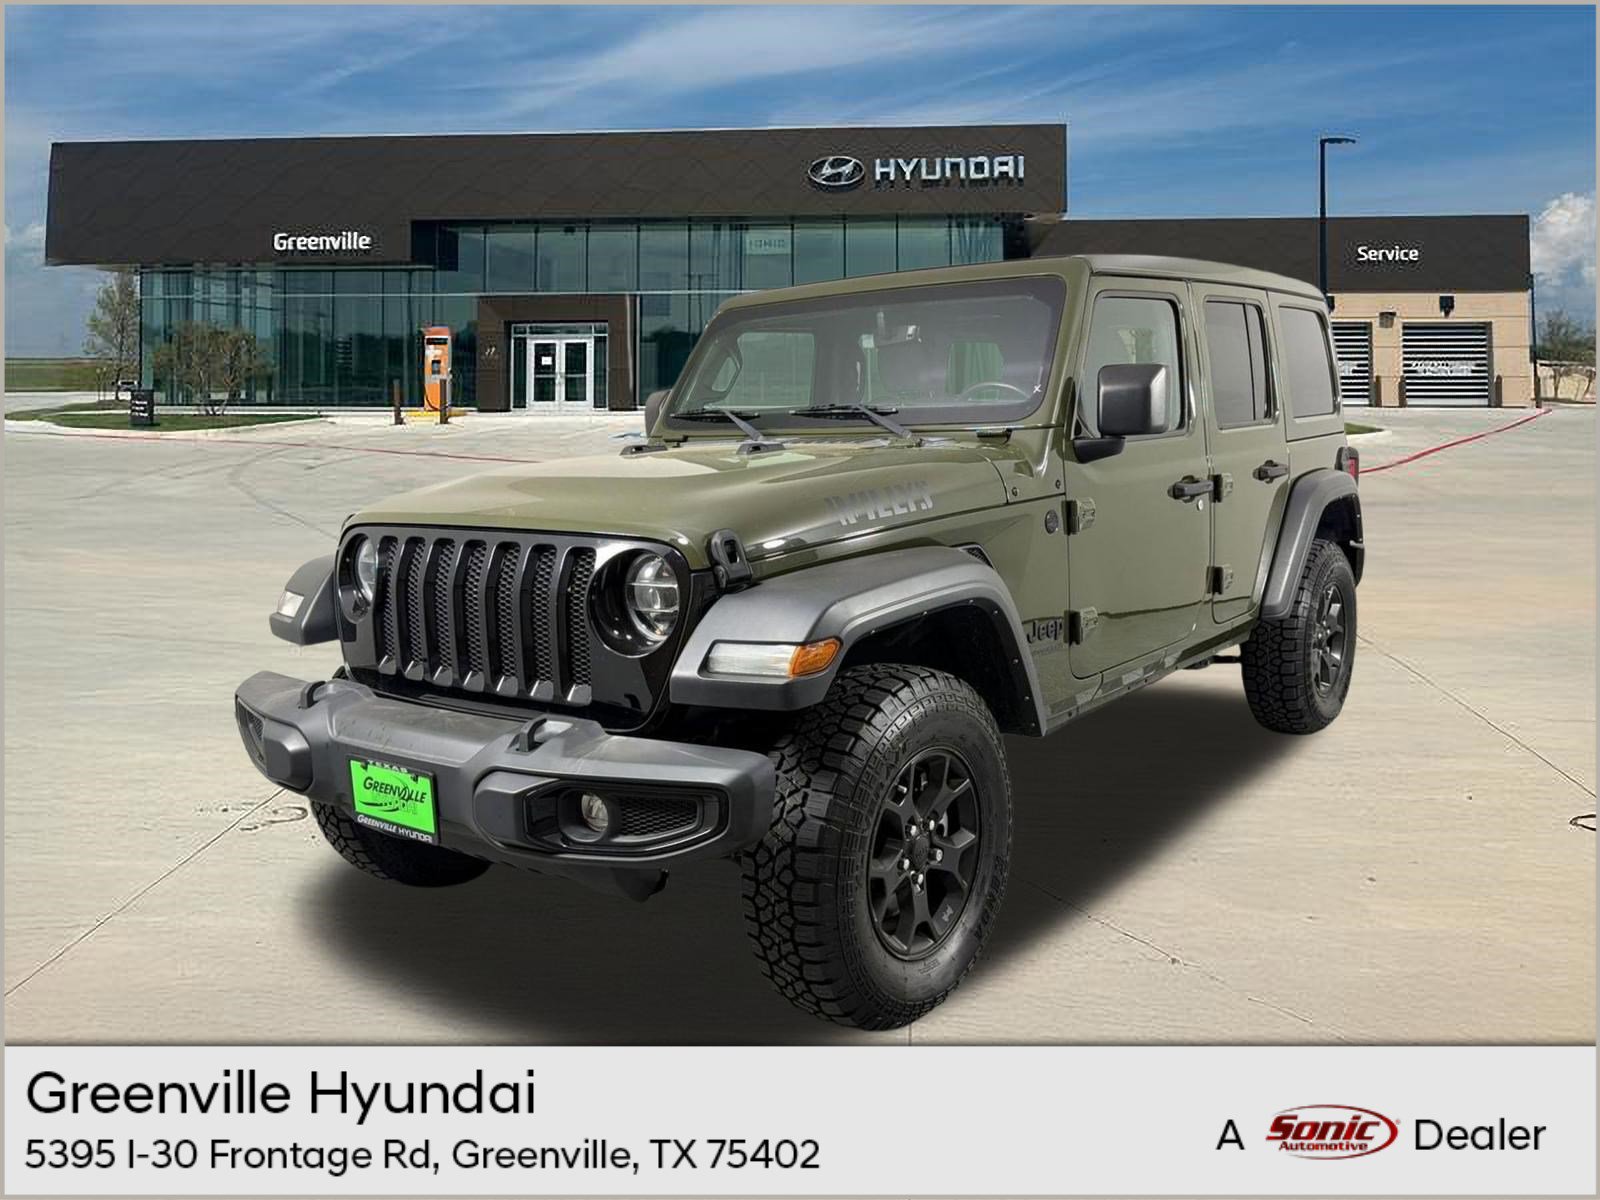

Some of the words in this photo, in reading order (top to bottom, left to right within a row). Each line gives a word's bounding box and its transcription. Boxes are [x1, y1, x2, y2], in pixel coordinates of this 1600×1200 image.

[874, 155, 1025, 181] HYUNDAI
[273, 231, 372, 251] Greenville
[1357, 245, 1419, 261] Service
[1026, 620, 1063, 645] Jeep
[363, 776, 426, 803] GREENVILLE
[357, 814, 397, 832] GREENVILLE
